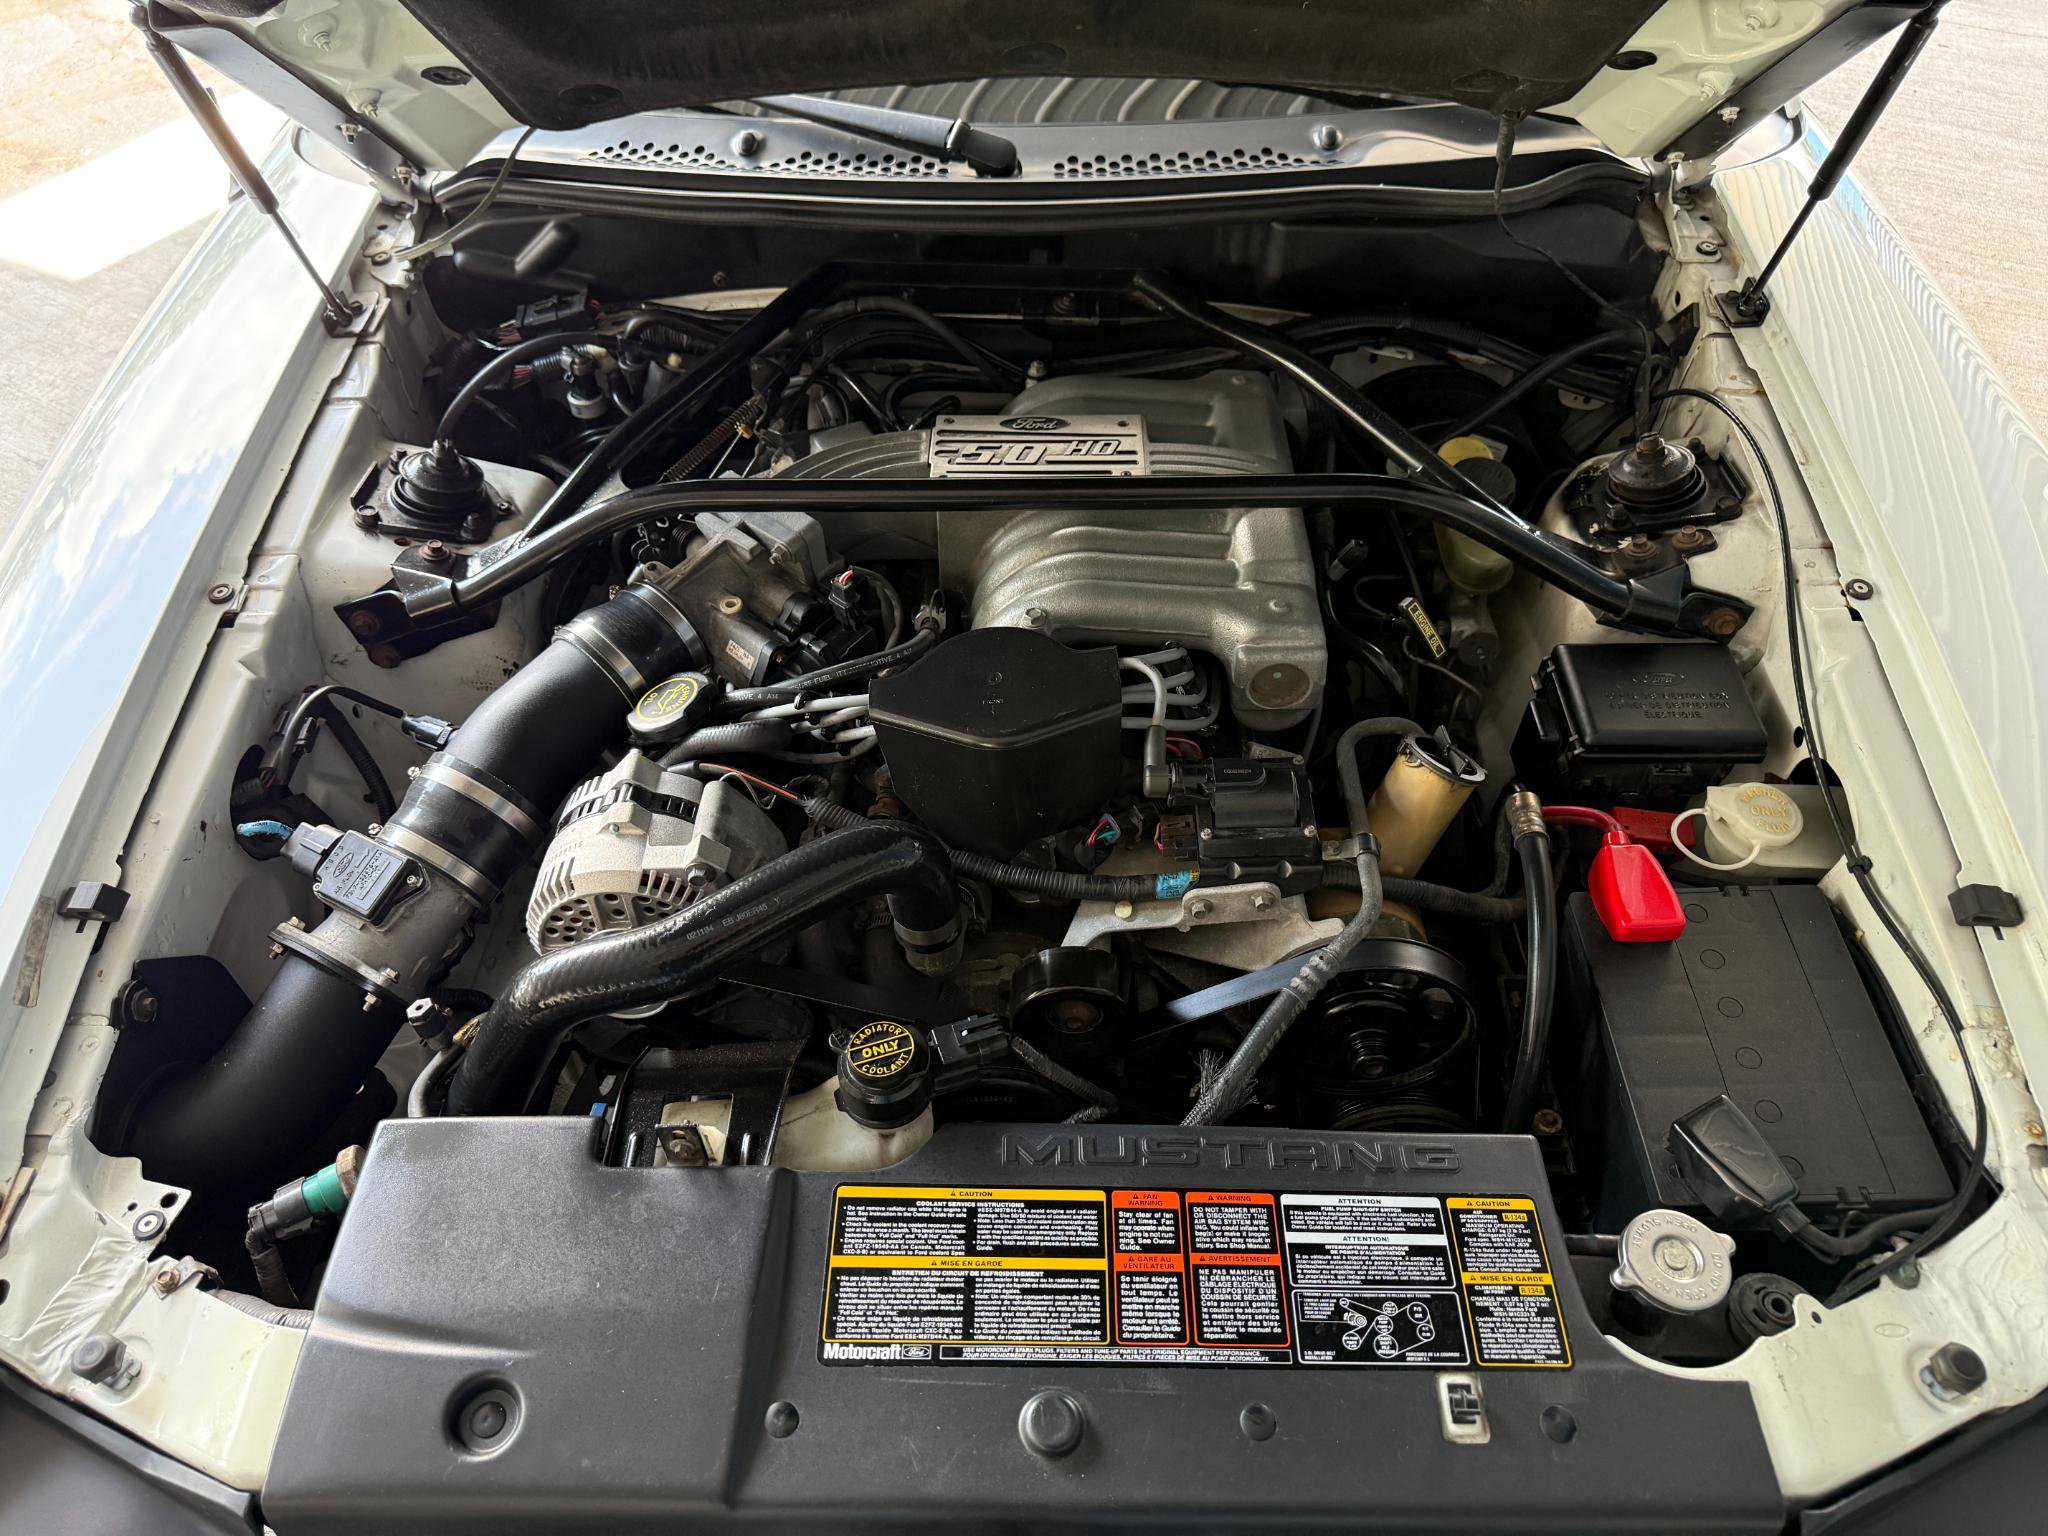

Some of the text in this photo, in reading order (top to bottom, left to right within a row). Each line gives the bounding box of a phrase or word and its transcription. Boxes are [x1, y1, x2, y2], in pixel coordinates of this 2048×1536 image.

[1012, 417, 1058, 429] Ford
[955, 440, 1121, 465] 5.0 HO
[1414, 610, 1440, 650] ENGINE OIL
[644, 692, 658, 706] OIL
[666, 686, 690, 712] ENGINE
[1751, 806, 1787, 817] ONLY
[854, 1024, 902, 1045] RADIATOR
[862, 1040, 899, 1058] ONLY
[862, 1052, 909, 1074] COOLANT
[1001, 1134, 1462, 1175] MUSTANG
[823, 1343, 900, 1360] Motorcraft
